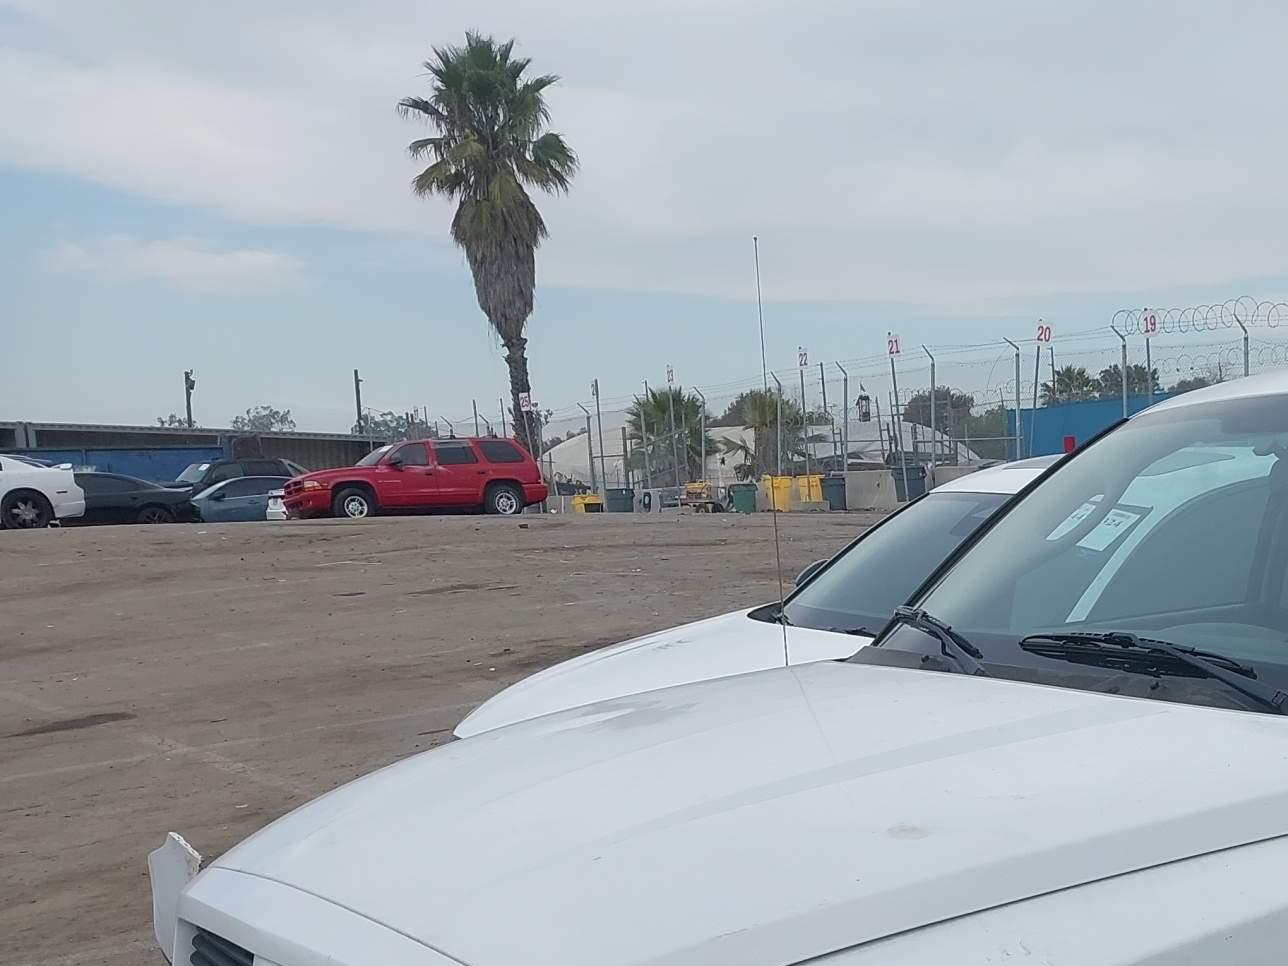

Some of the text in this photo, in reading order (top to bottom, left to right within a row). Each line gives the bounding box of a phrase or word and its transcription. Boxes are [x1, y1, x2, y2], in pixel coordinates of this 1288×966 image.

[1143, 315, 1156, 333] 19
[1037, 325, 1051, 342] 20
[888, 339, 900, 354] 21
[799, 352, 808, 366] 22
[520, 398, 530, 408] 25
